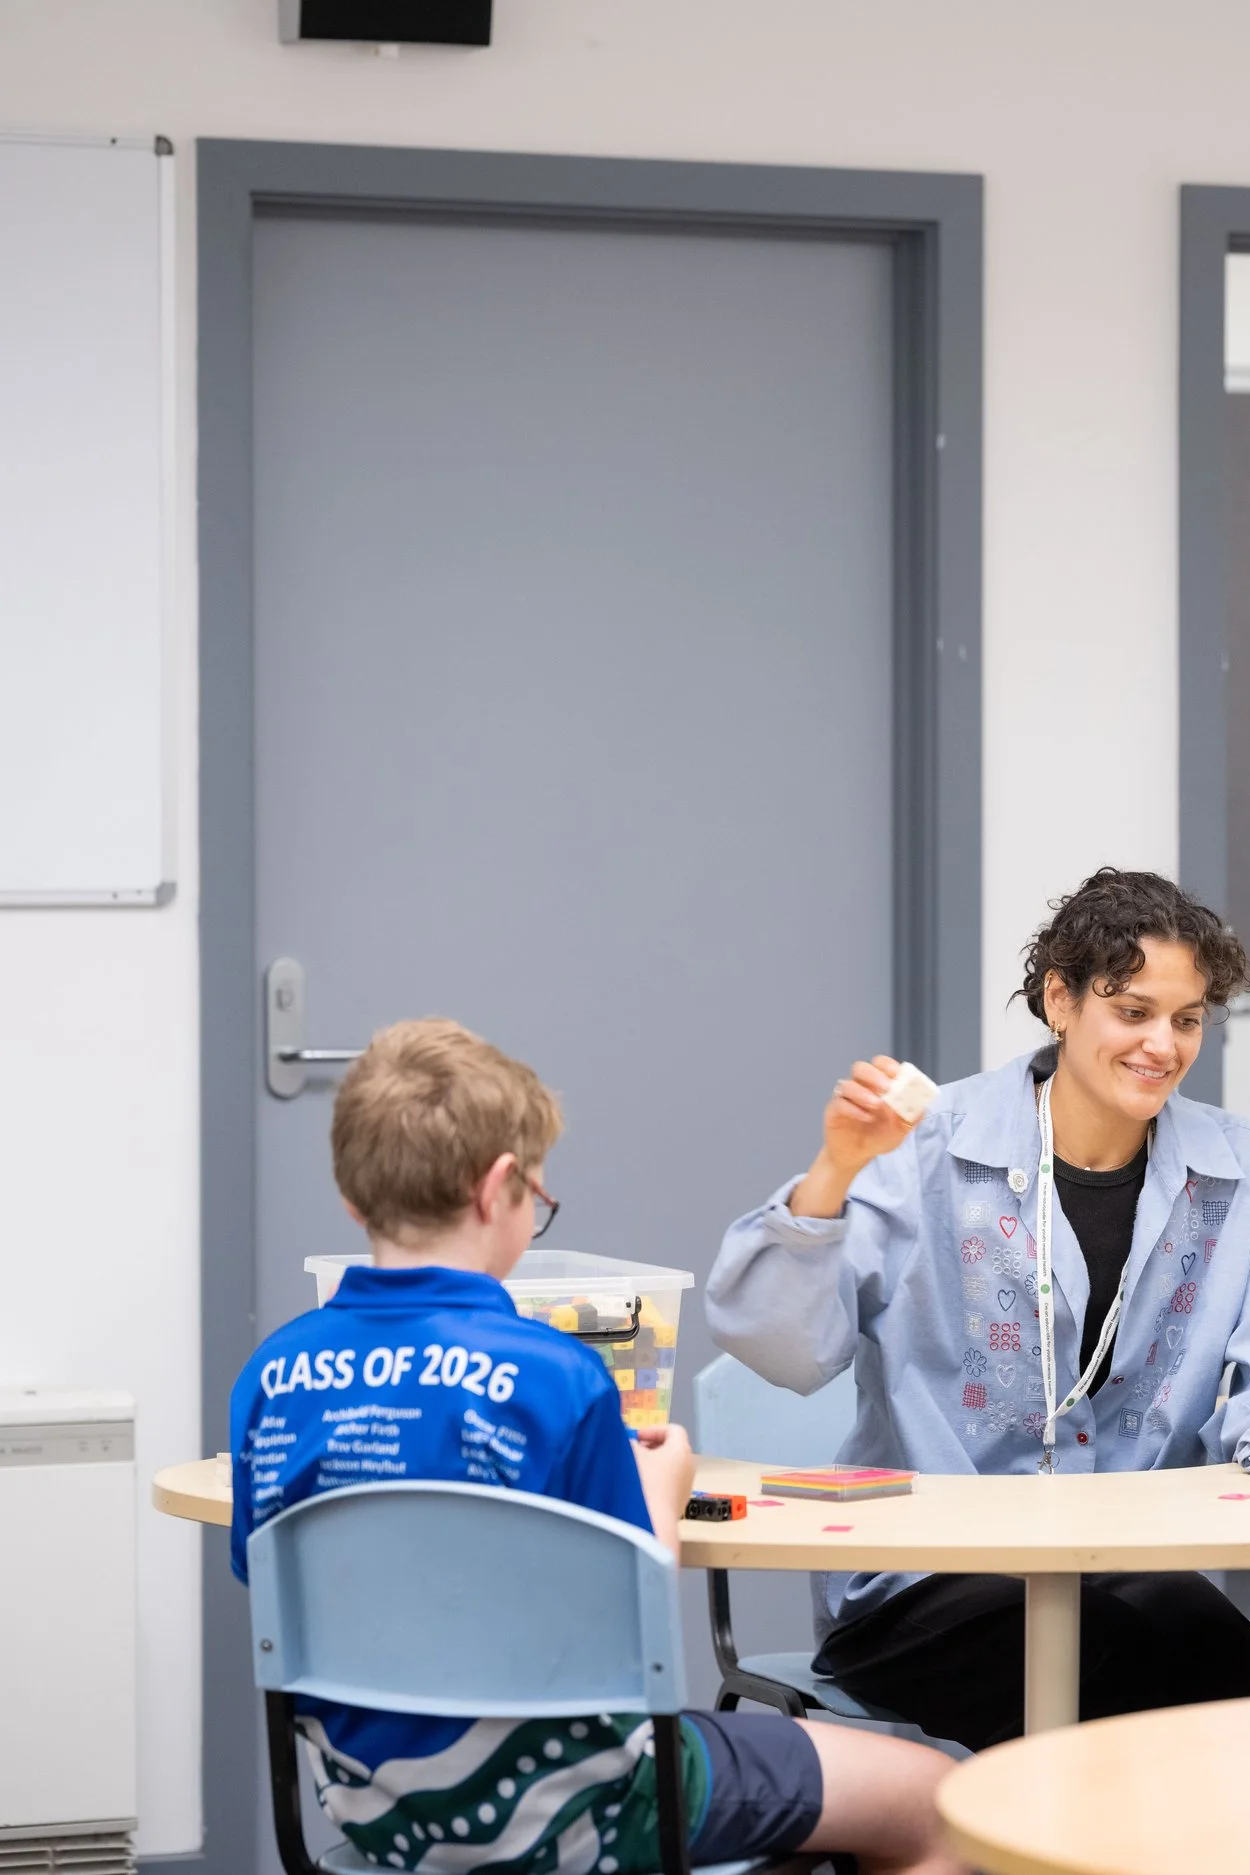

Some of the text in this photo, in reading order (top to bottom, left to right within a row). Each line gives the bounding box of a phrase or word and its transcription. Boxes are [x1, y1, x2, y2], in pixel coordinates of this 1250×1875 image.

[260, 1344, 519, 1403] CLASS OF 2026
